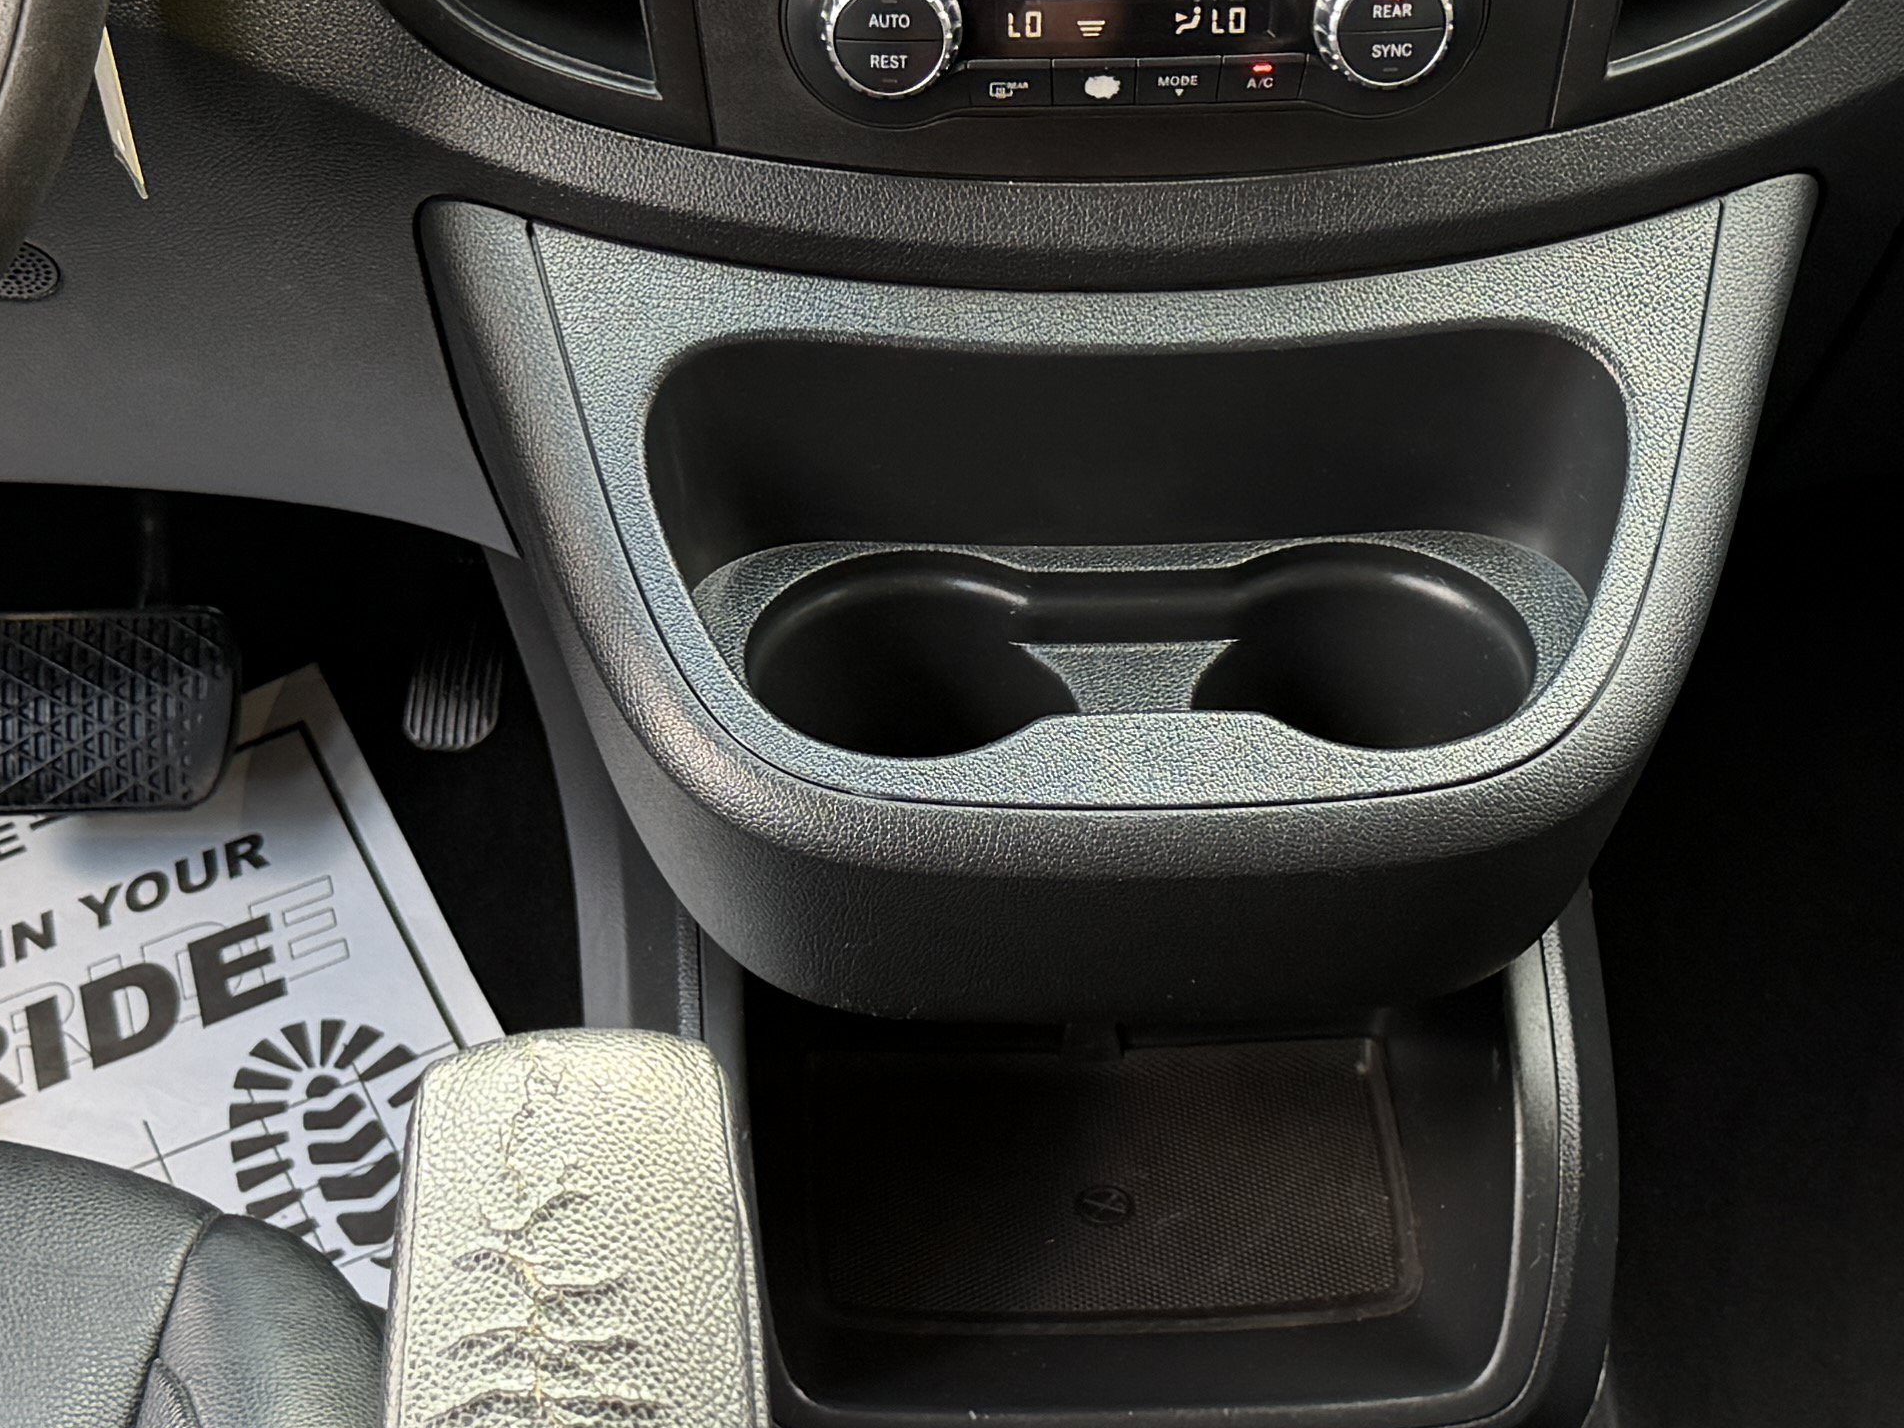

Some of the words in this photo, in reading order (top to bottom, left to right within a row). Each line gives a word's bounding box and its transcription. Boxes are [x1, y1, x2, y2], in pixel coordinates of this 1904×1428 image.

[1372, 3, 1413, 19] REAR
[868, 13, 910, 28] AUTO
[1007, 10, 1042, 38] LO
[1211, 6, 1246, 34] LO
[1371, 42, 1413, 59] SYNC
[869, 54, 908, 69] REST
[1157, 75, 1199, 88] MODE
[1247, 76, 1274, 90] A/C
[77, 831, 272, 930] YOUR
